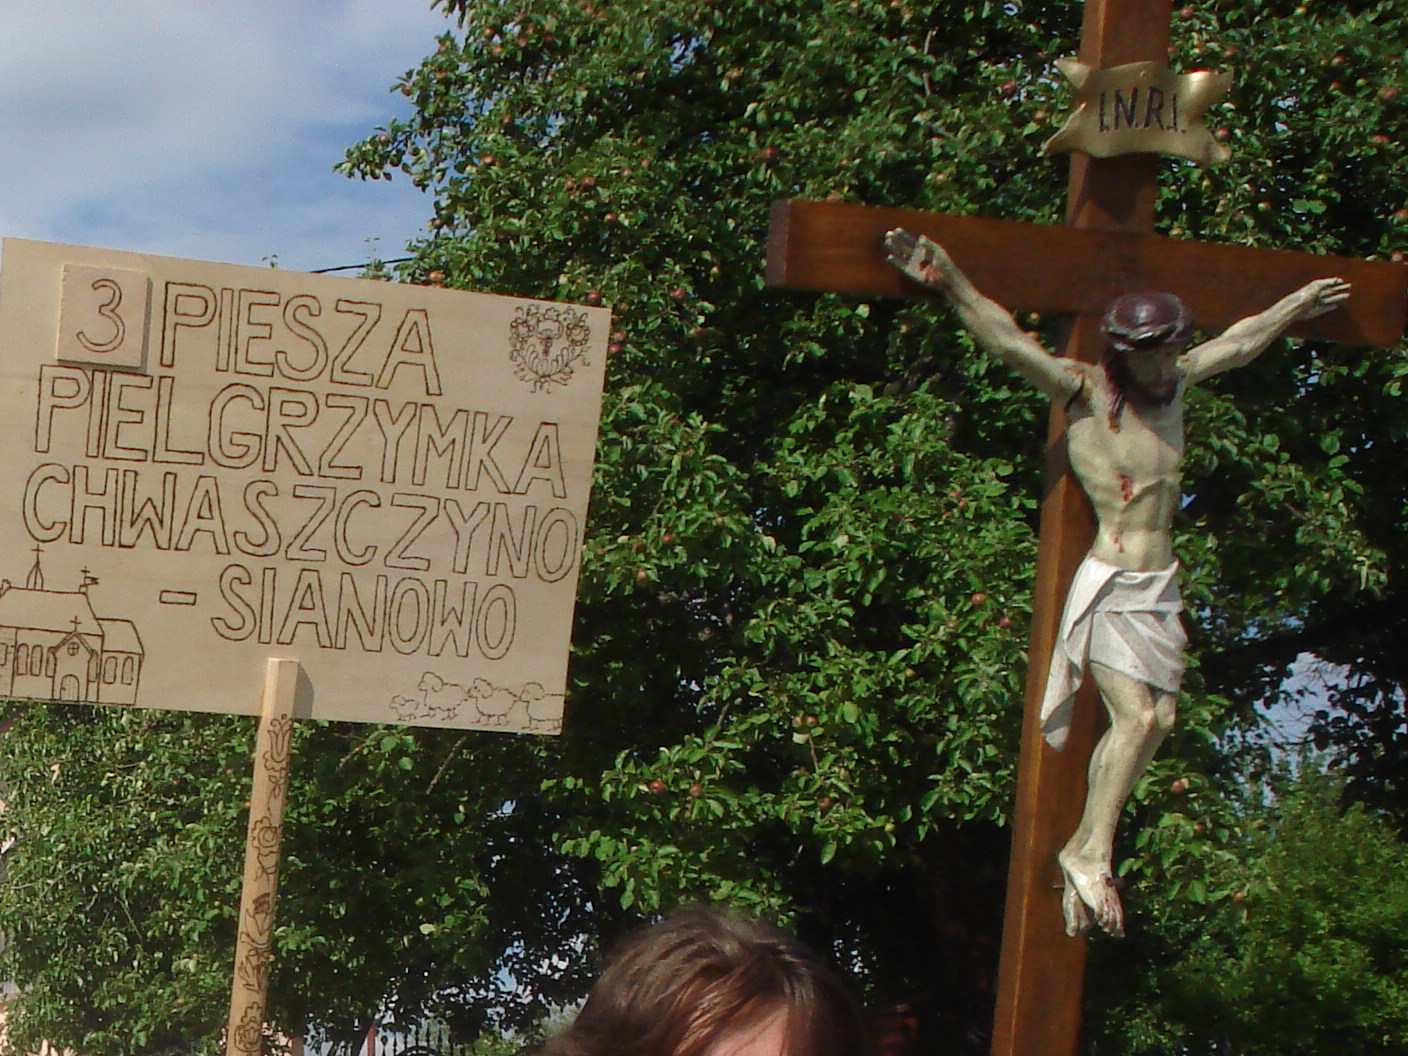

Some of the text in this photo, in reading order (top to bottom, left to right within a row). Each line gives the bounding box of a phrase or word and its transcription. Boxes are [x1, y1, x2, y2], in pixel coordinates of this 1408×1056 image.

[75, 277, 443, 396] 3 PIESZA
[34, 363, 568, 499] PIELGRZYMKA
[22, 463, 578, 584] CHWASZCZYNO
[211, 564, 517, 660] SIANOWO
